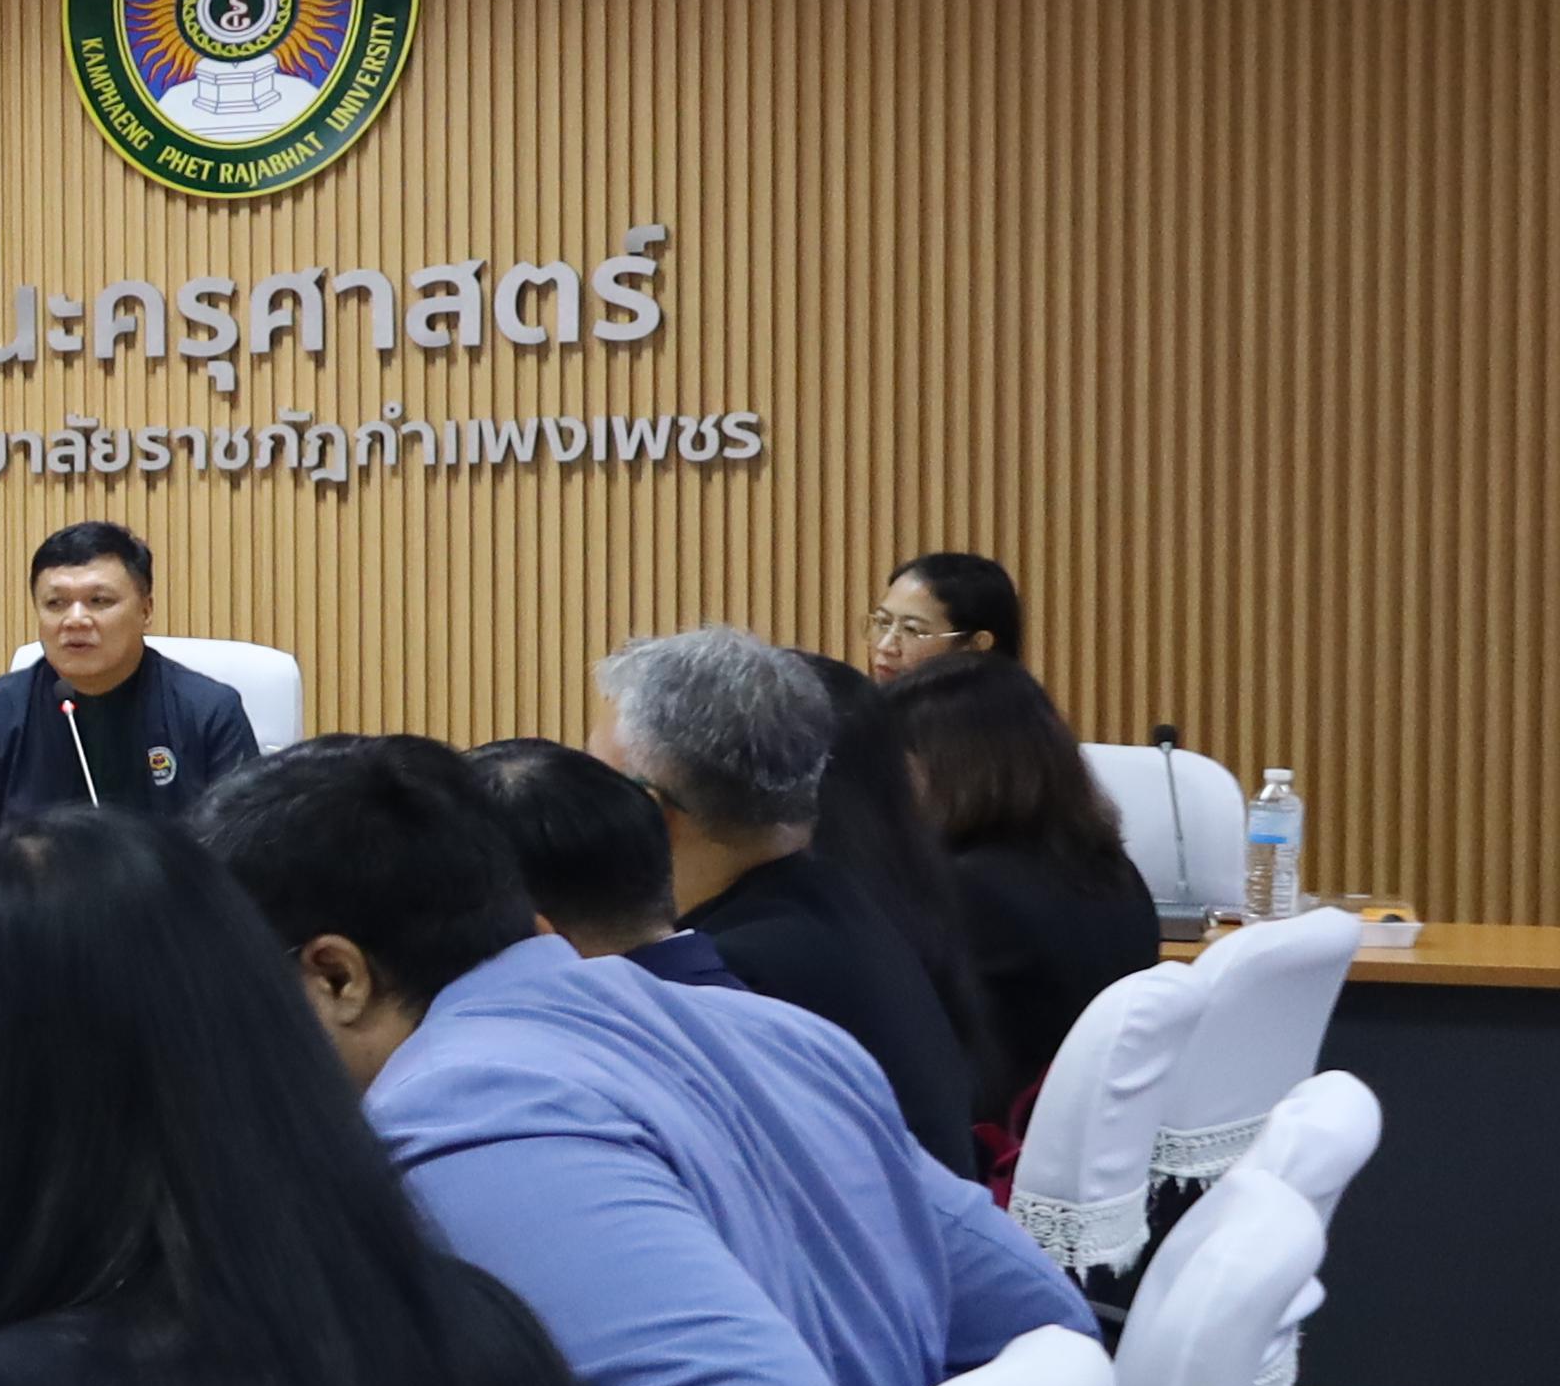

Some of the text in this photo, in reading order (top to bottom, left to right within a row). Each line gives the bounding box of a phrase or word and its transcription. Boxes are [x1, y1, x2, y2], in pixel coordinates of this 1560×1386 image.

[80, 13, 397, 188] KAMPHAENG PHET RAJABHAT UNIVERSITY
